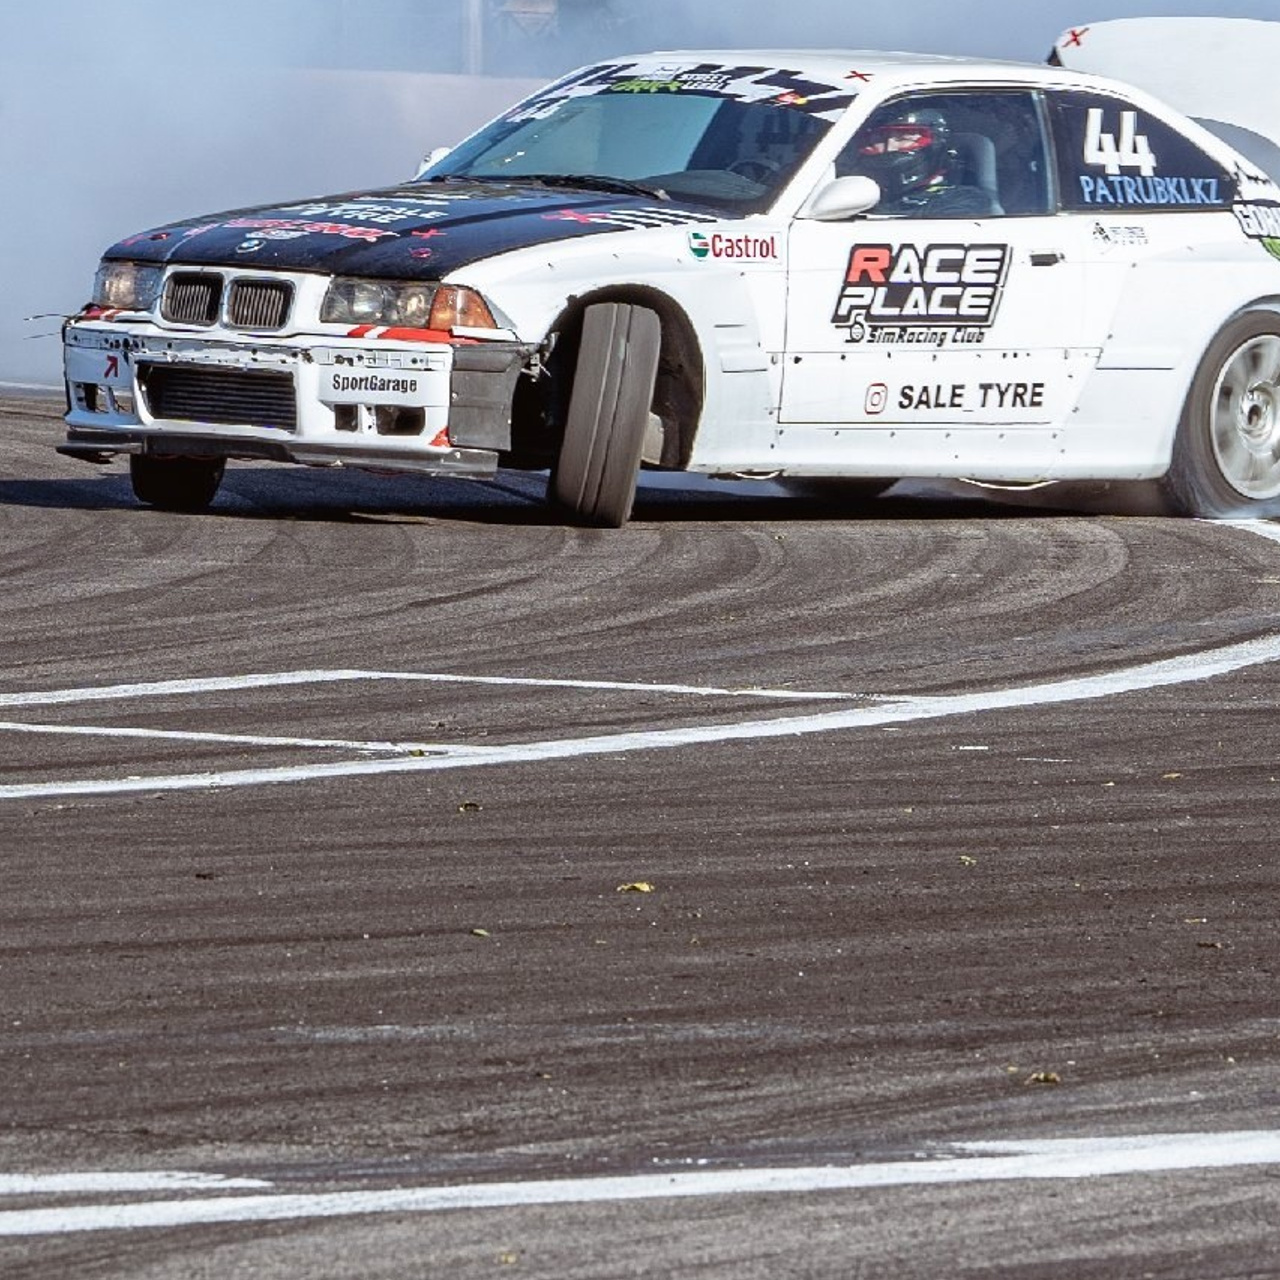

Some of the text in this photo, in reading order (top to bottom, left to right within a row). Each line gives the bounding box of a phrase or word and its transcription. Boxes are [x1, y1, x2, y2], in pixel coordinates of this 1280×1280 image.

[1084, 108, 1157, 177] 44
[711, 234, 778, 259] Castrol
[846, 247, 1004, 284] RACE
[837, 286, 995, 316] PLACE
[866, 326, 985, 347] SimRacing Club
[332, 373, 417, 394] SportGarage
[897, 382, 1045, 412] SALE_TYRE
